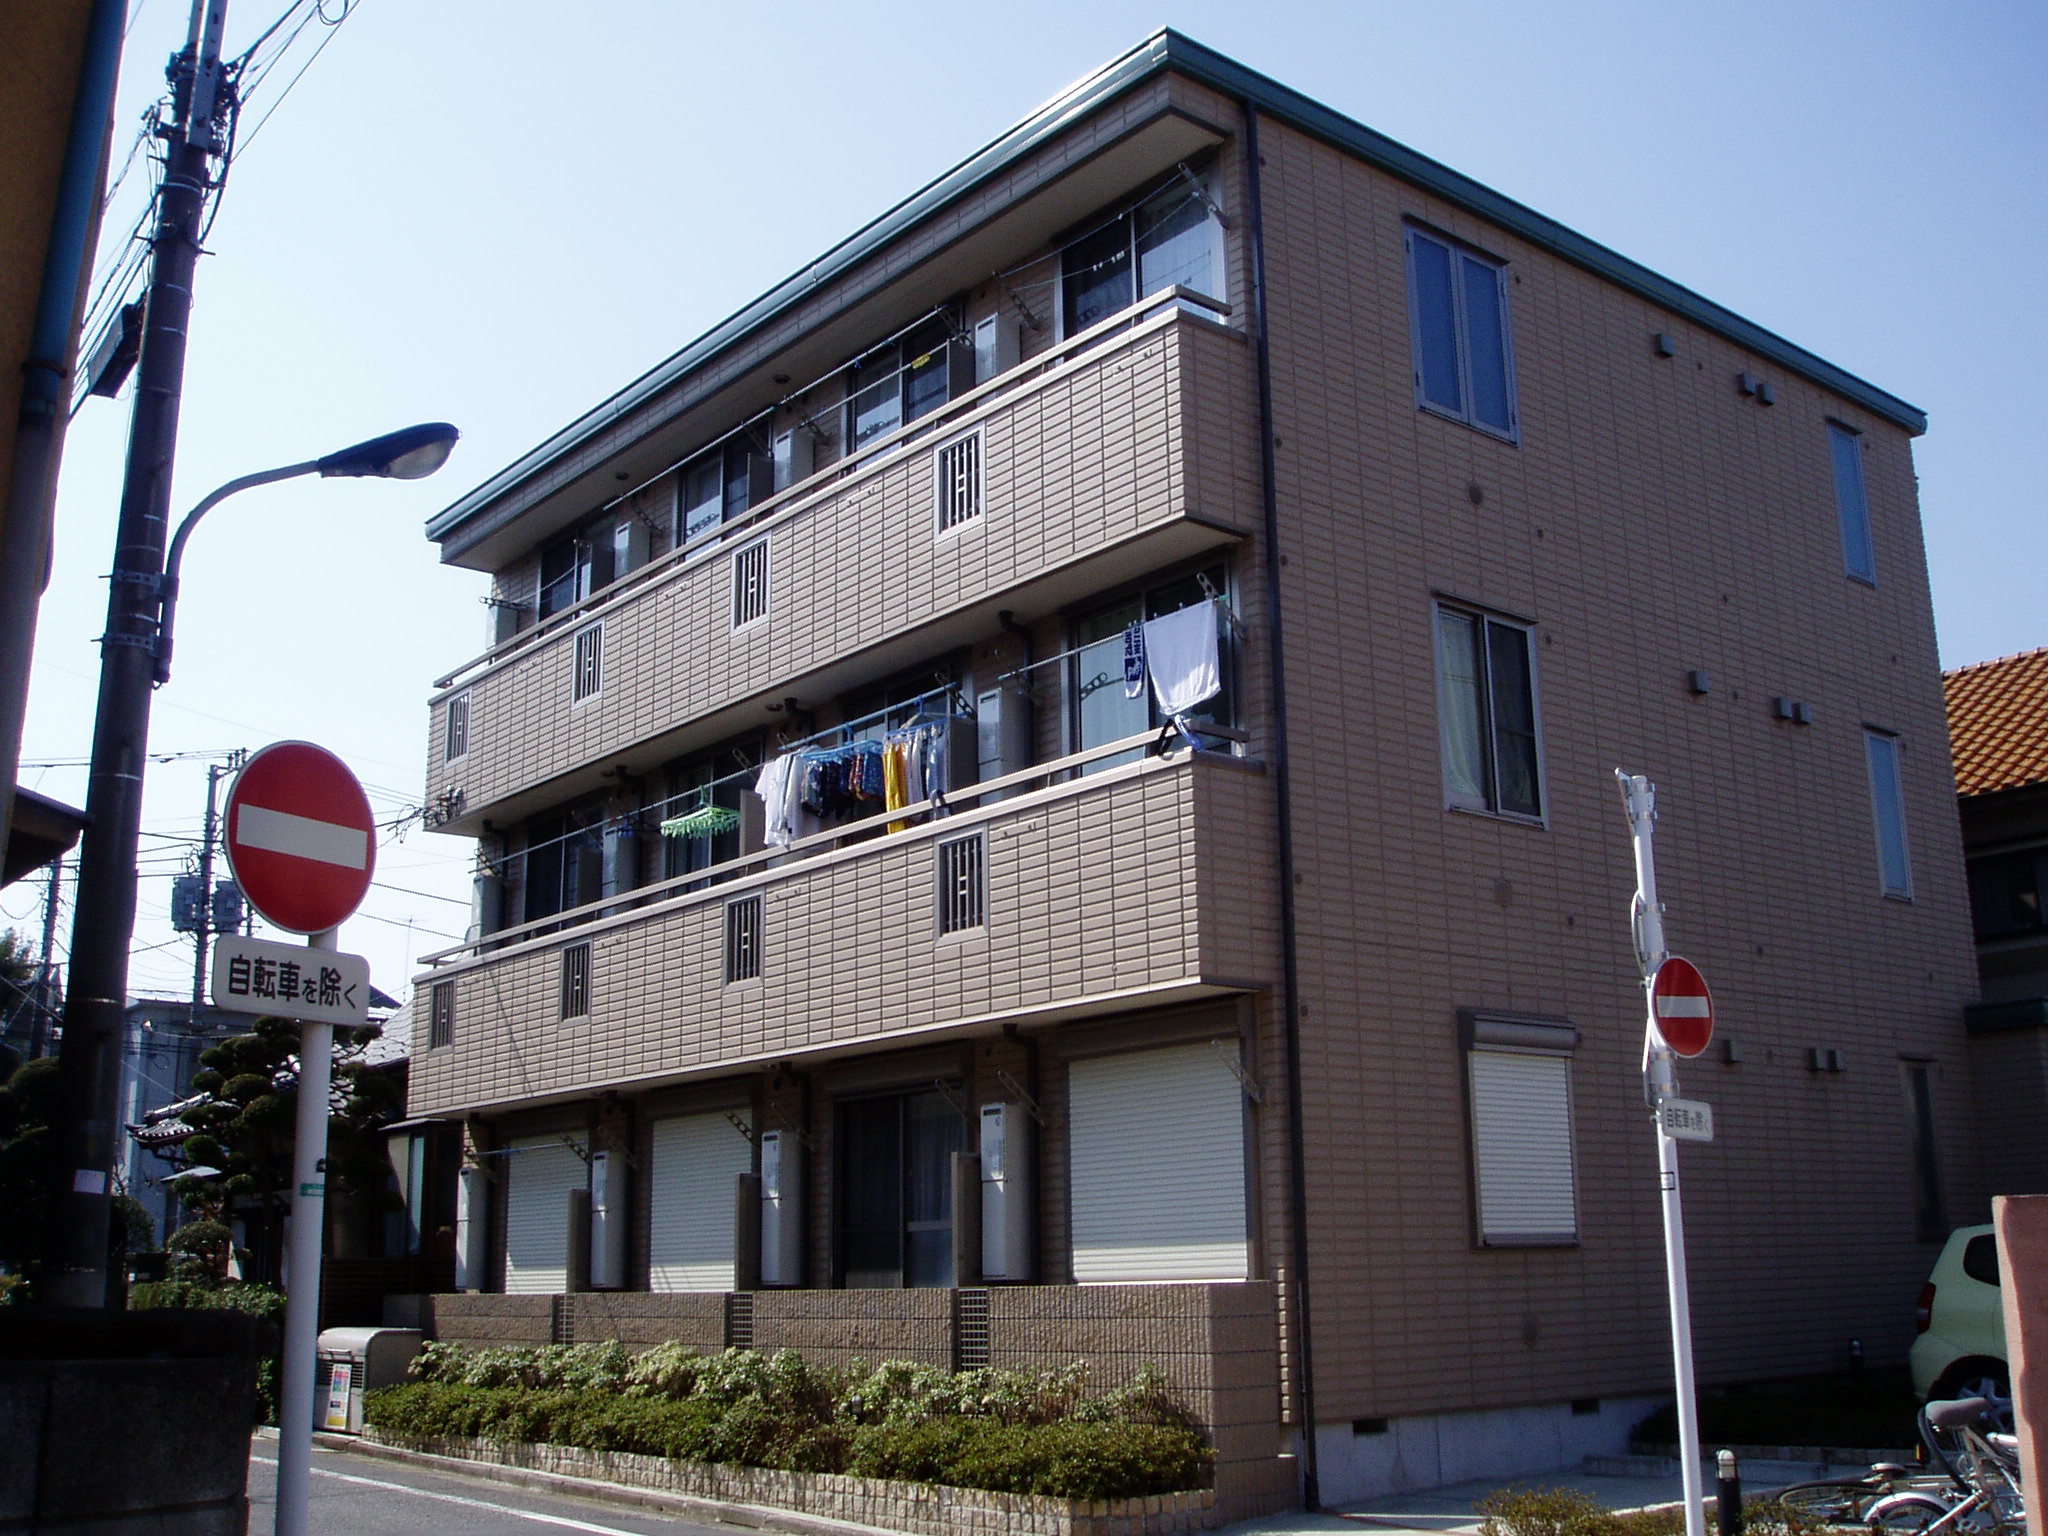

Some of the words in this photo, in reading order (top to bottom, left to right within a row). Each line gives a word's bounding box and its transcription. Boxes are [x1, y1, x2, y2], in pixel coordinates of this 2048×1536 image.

[228, 953, 358, 1010] 自転車を除く
